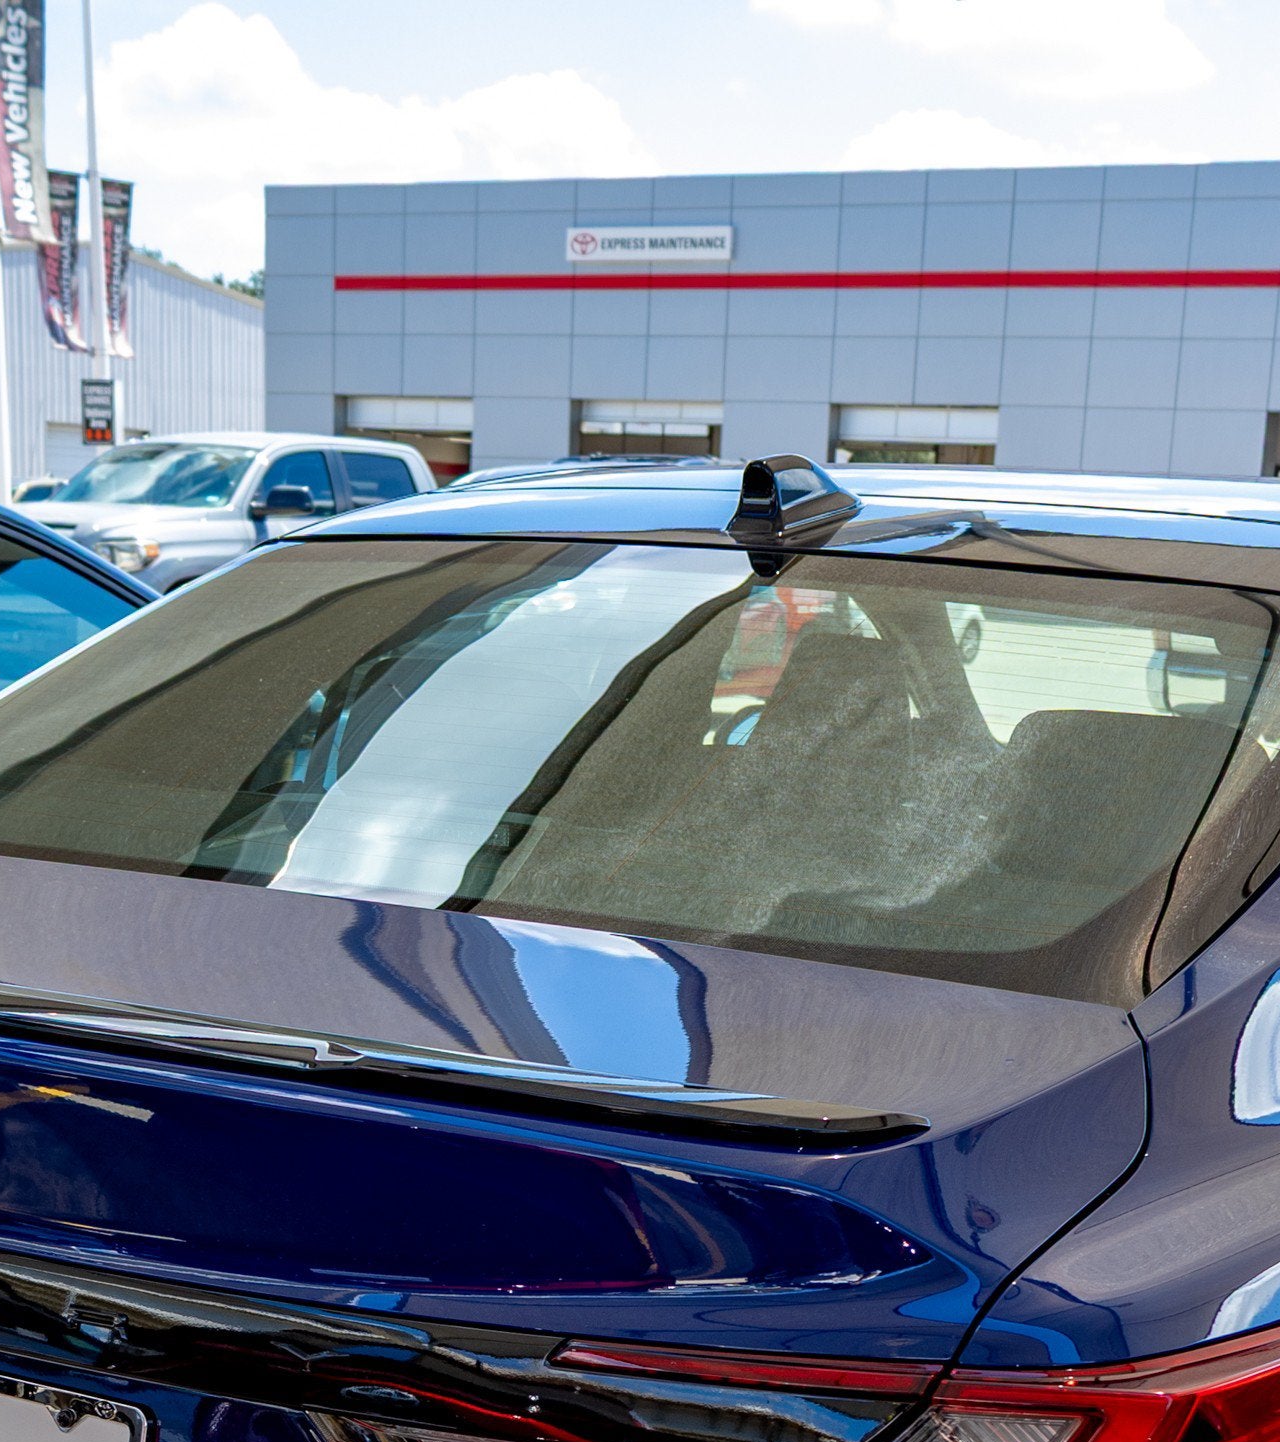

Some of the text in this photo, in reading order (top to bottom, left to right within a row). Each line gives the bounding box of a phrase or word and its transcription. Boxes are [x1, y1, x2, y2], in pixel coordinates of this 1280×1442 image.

[2, 5, 38, 224] New Vehicles
[112, 223, 124, 332] MAINTENANCE
[601, 236, 725, 250] EXPRESS MAINTENANCE
